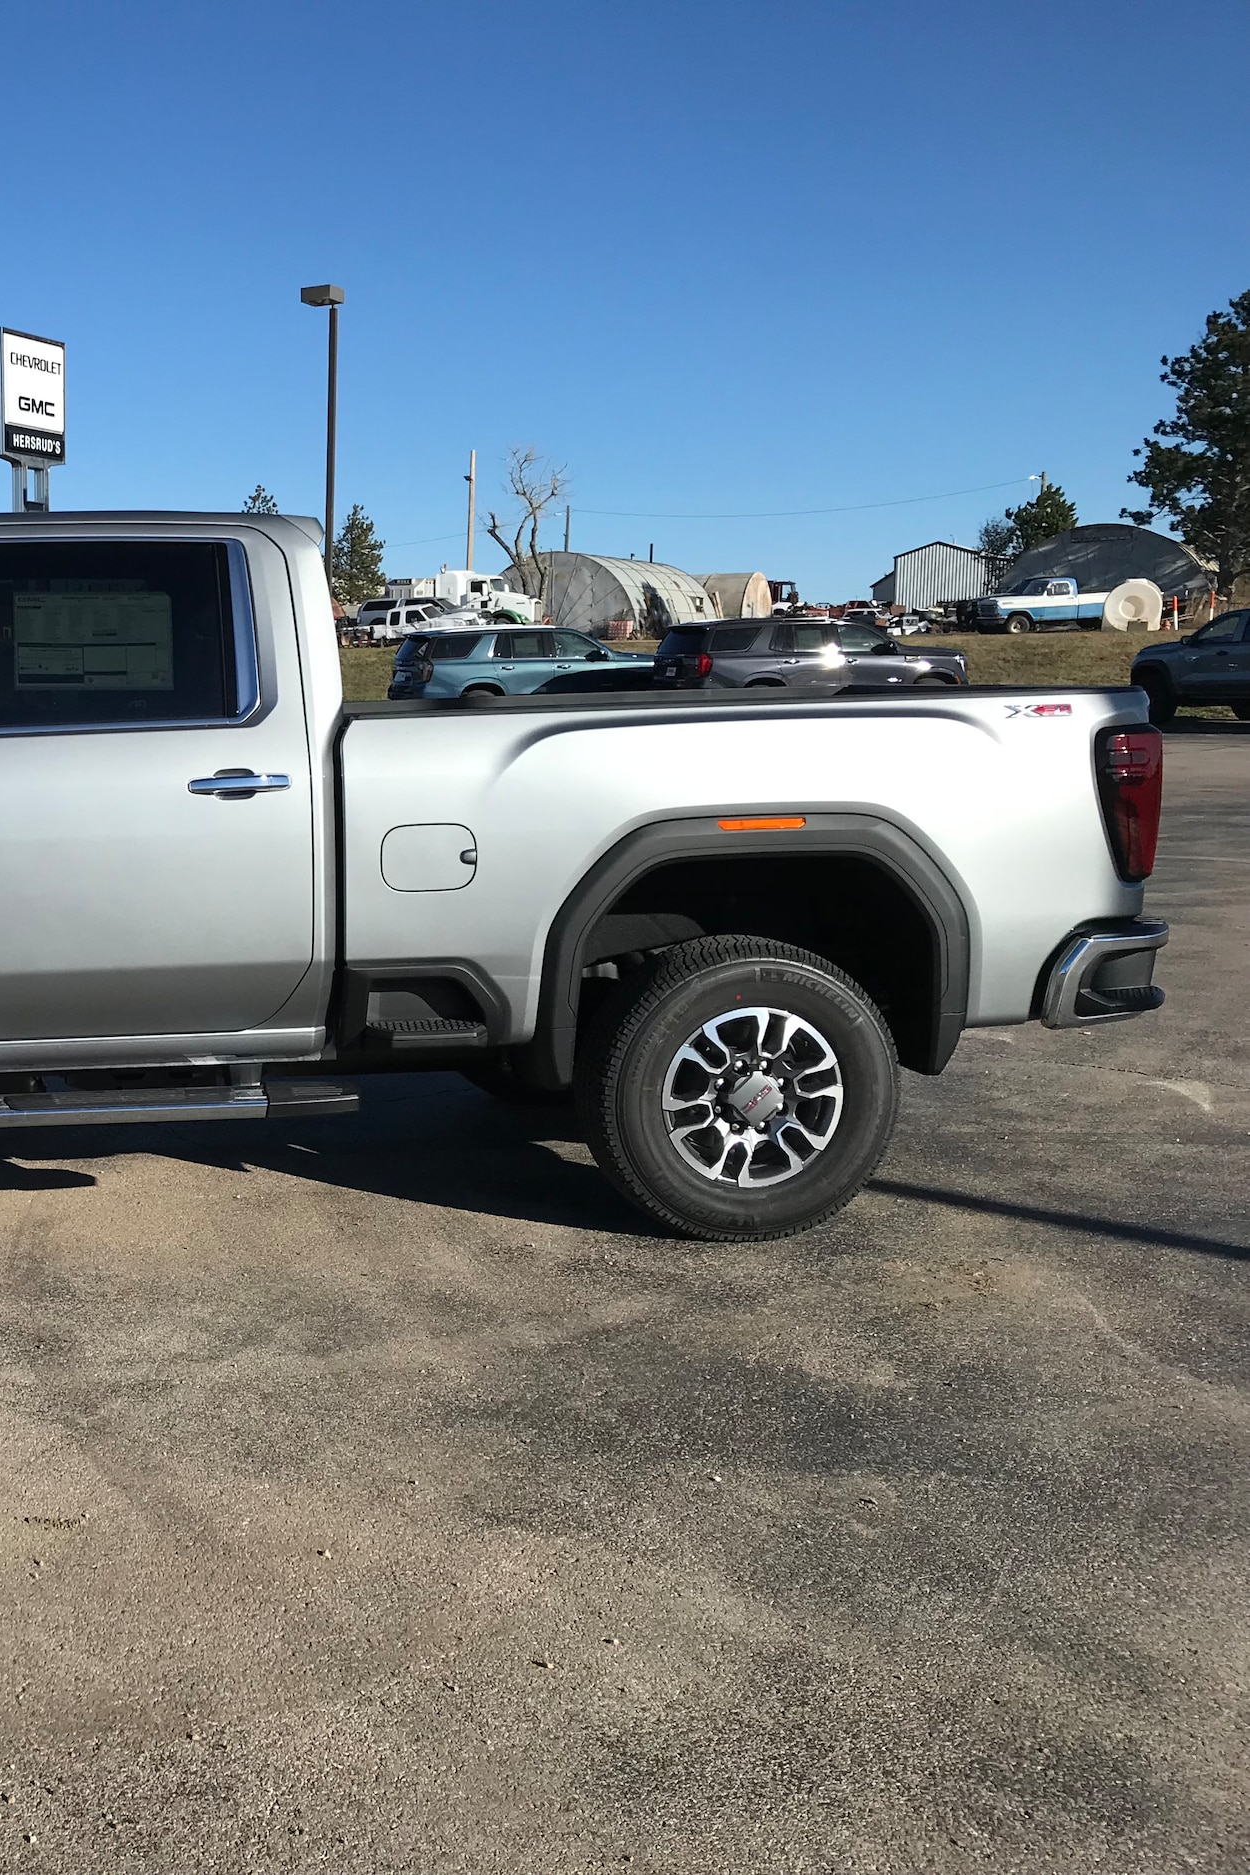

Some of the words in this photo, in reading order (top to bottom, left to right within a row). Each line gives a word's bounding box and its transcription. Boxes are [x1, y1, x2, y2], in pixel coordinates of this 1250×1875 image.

[10, 351, 61, 375] CHEVROLET
[18, 396, 55, 417] GMC
[13, 433, 61, 455] HERSRUD'S
[783, 972, 859, 1019] MICHELIN
